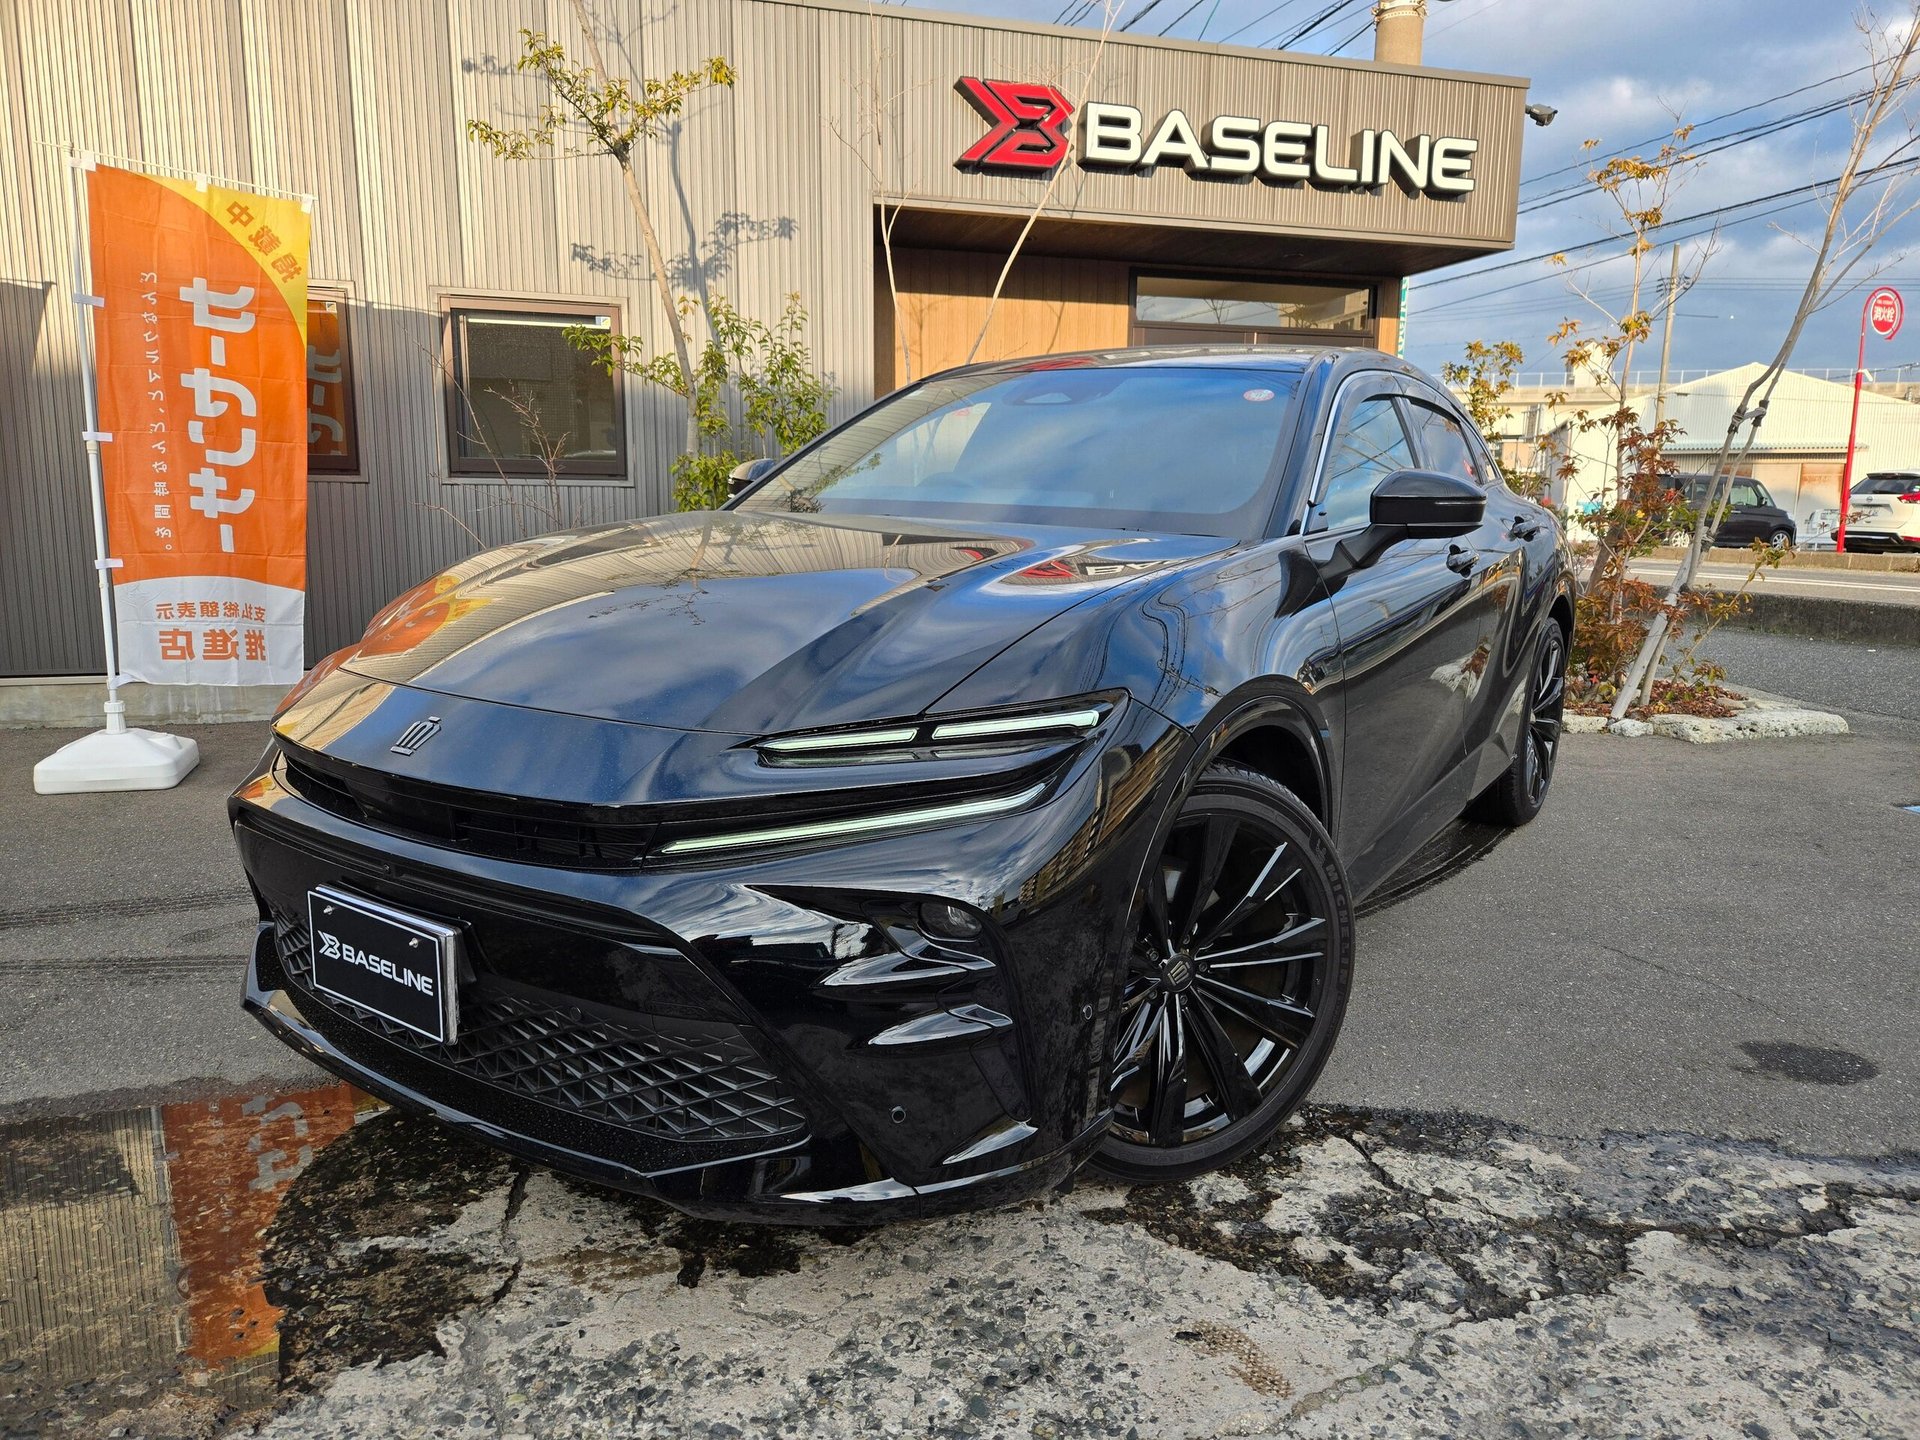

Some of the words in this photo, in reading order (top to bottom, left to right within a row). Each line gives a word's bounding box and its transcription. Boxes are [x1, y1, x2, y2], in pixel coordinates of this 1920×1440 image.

[1084, 102, 1479, 191] BASELINE
[1327, 864, 1351, 985] MICHELIN
[342, 943, 433, 996] BASELINE
